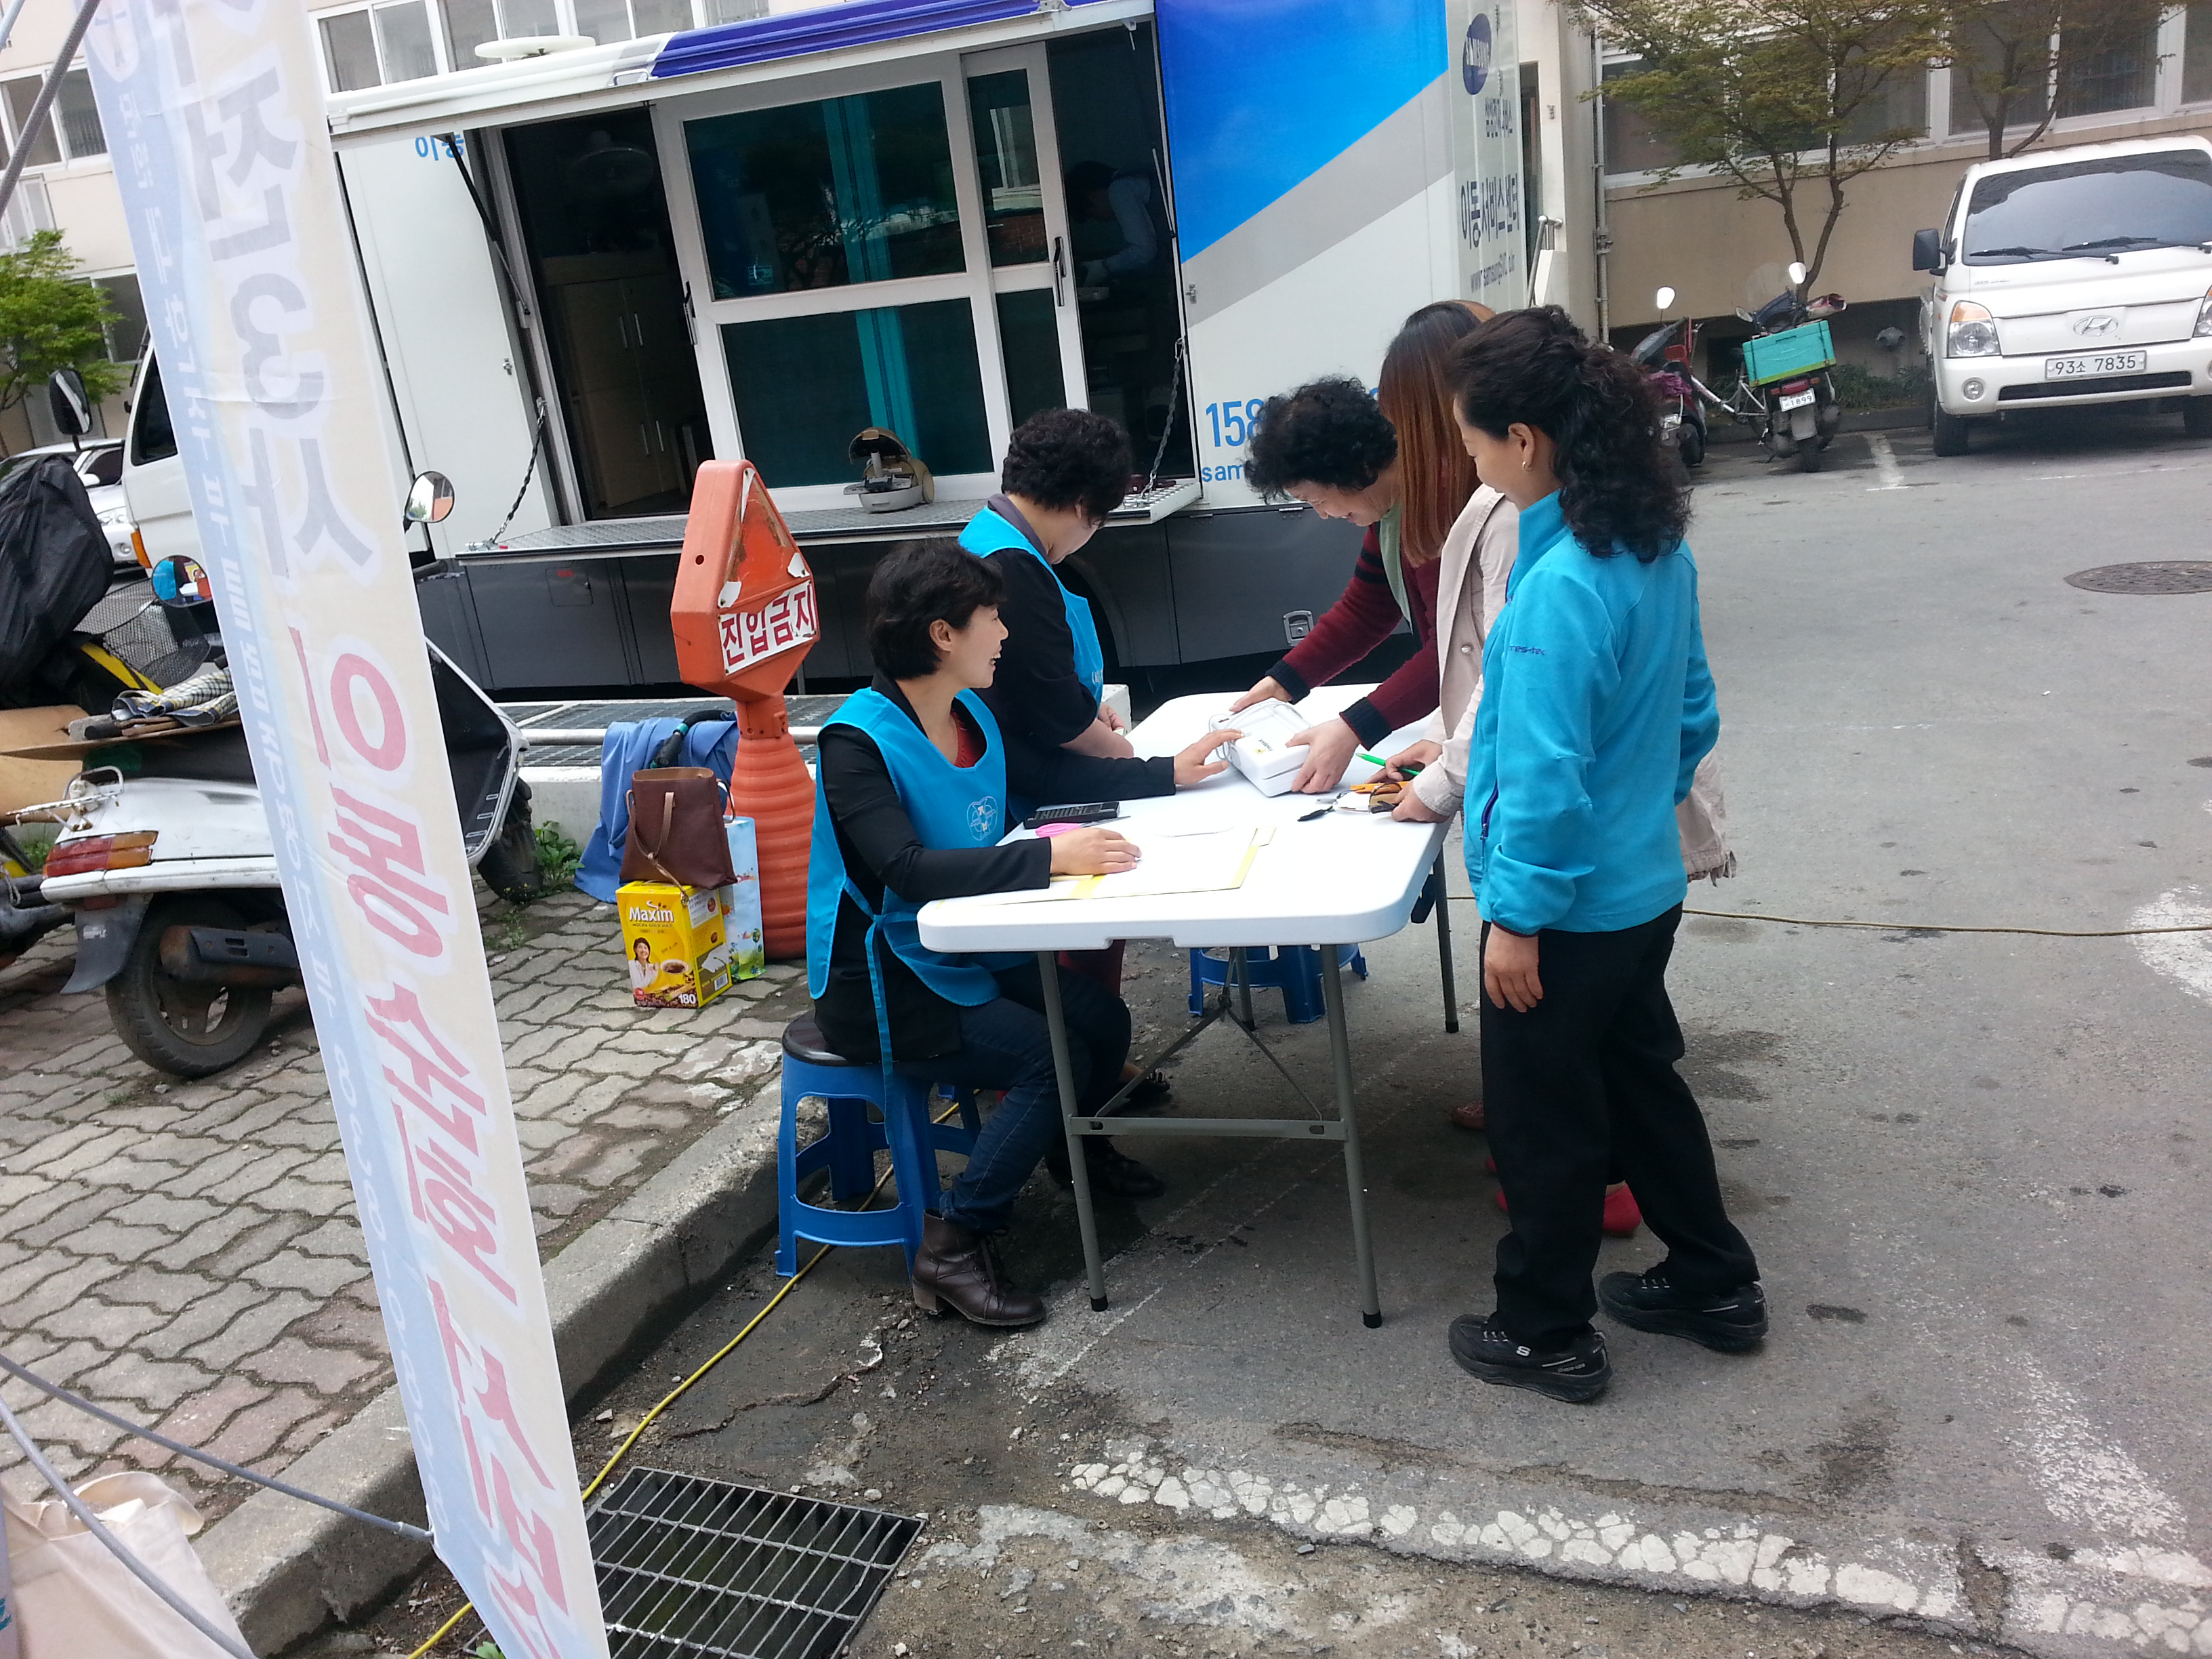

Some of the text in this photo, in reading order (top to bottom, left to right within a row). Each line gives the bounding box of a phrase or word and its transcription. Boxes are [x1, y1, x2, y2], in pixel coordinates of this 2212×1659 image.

[1460, 173, 1519, 249] 이동서비스센터
[2055, 355, 2136, 375] 93소 7835
[1790, 395, 1813, 407] 1899
[722, 584, 815, 667] 진입금지
[629, 906, 675, 922] Maxim
[678, 994, 697, 1004] 180
